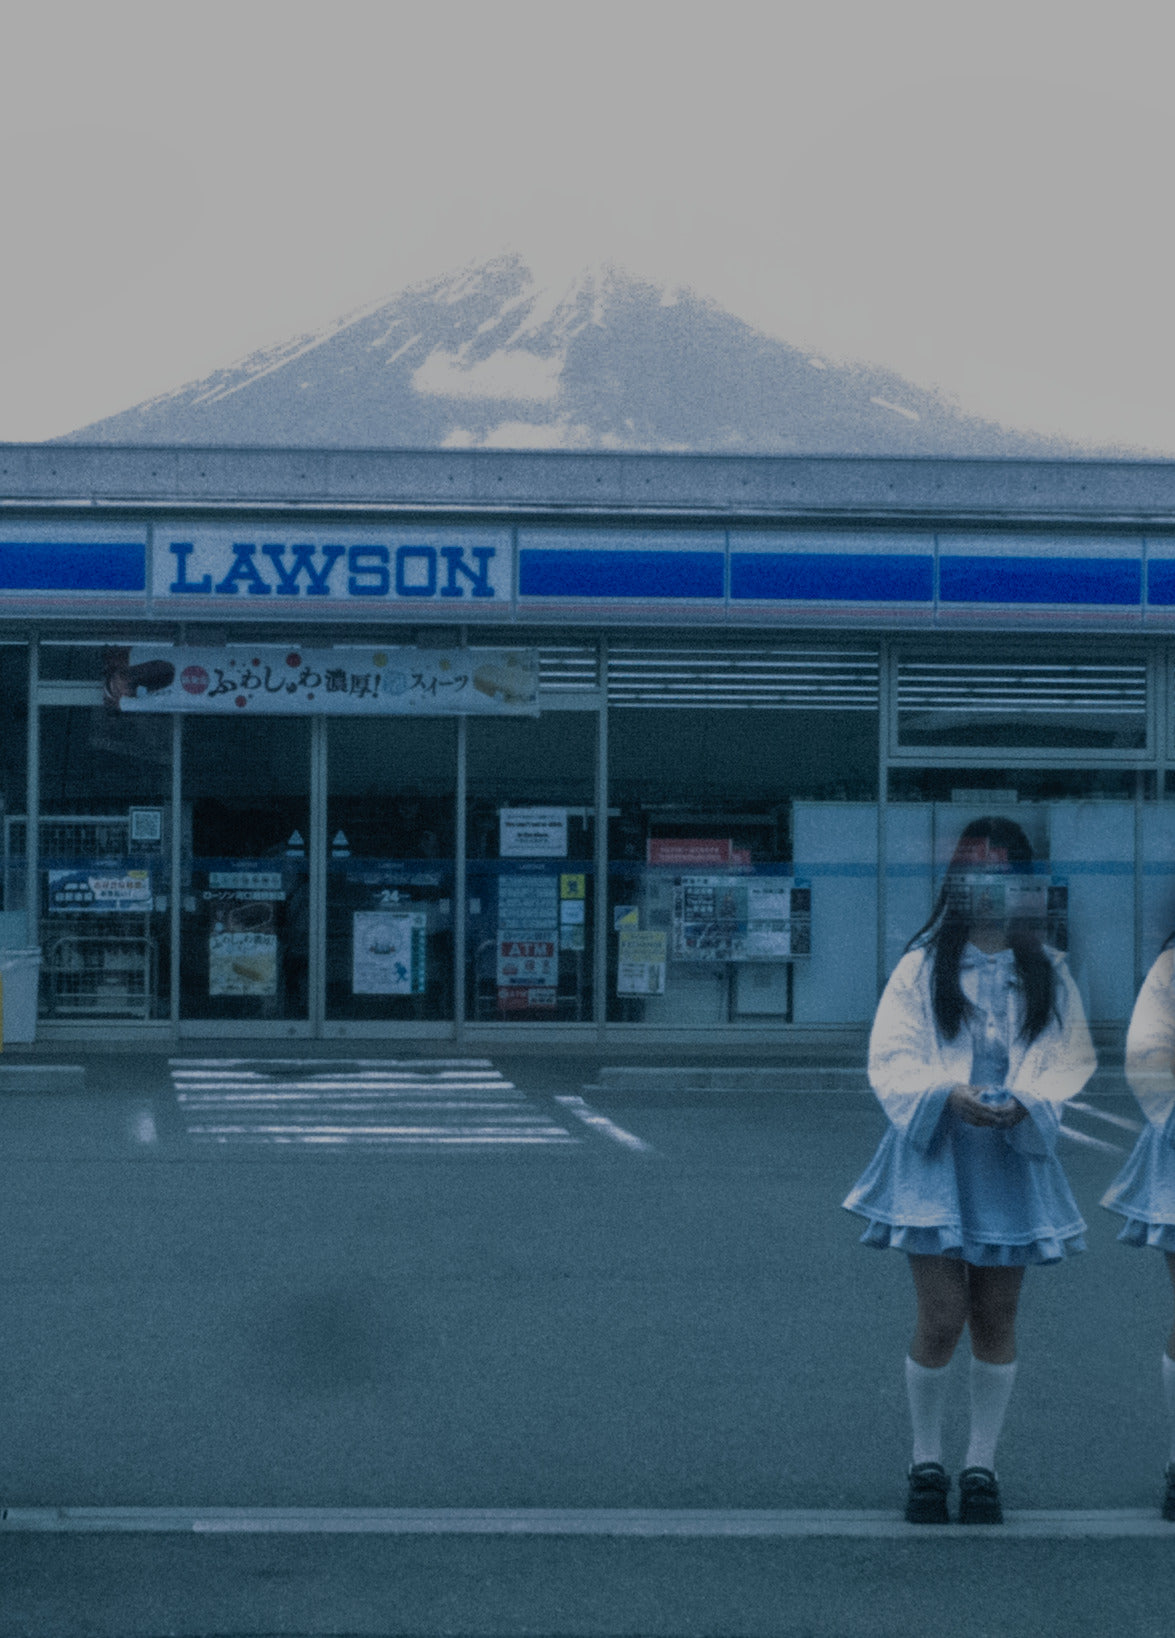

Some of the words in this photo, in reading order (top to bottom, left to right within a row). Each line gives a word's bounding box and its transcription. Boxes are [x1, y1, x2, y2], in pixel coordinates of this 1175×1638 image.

[169, 542, 496, 598] LAWSON
[381, 889, 399, 902] 24
[508, 943, 549, 957] ATM
